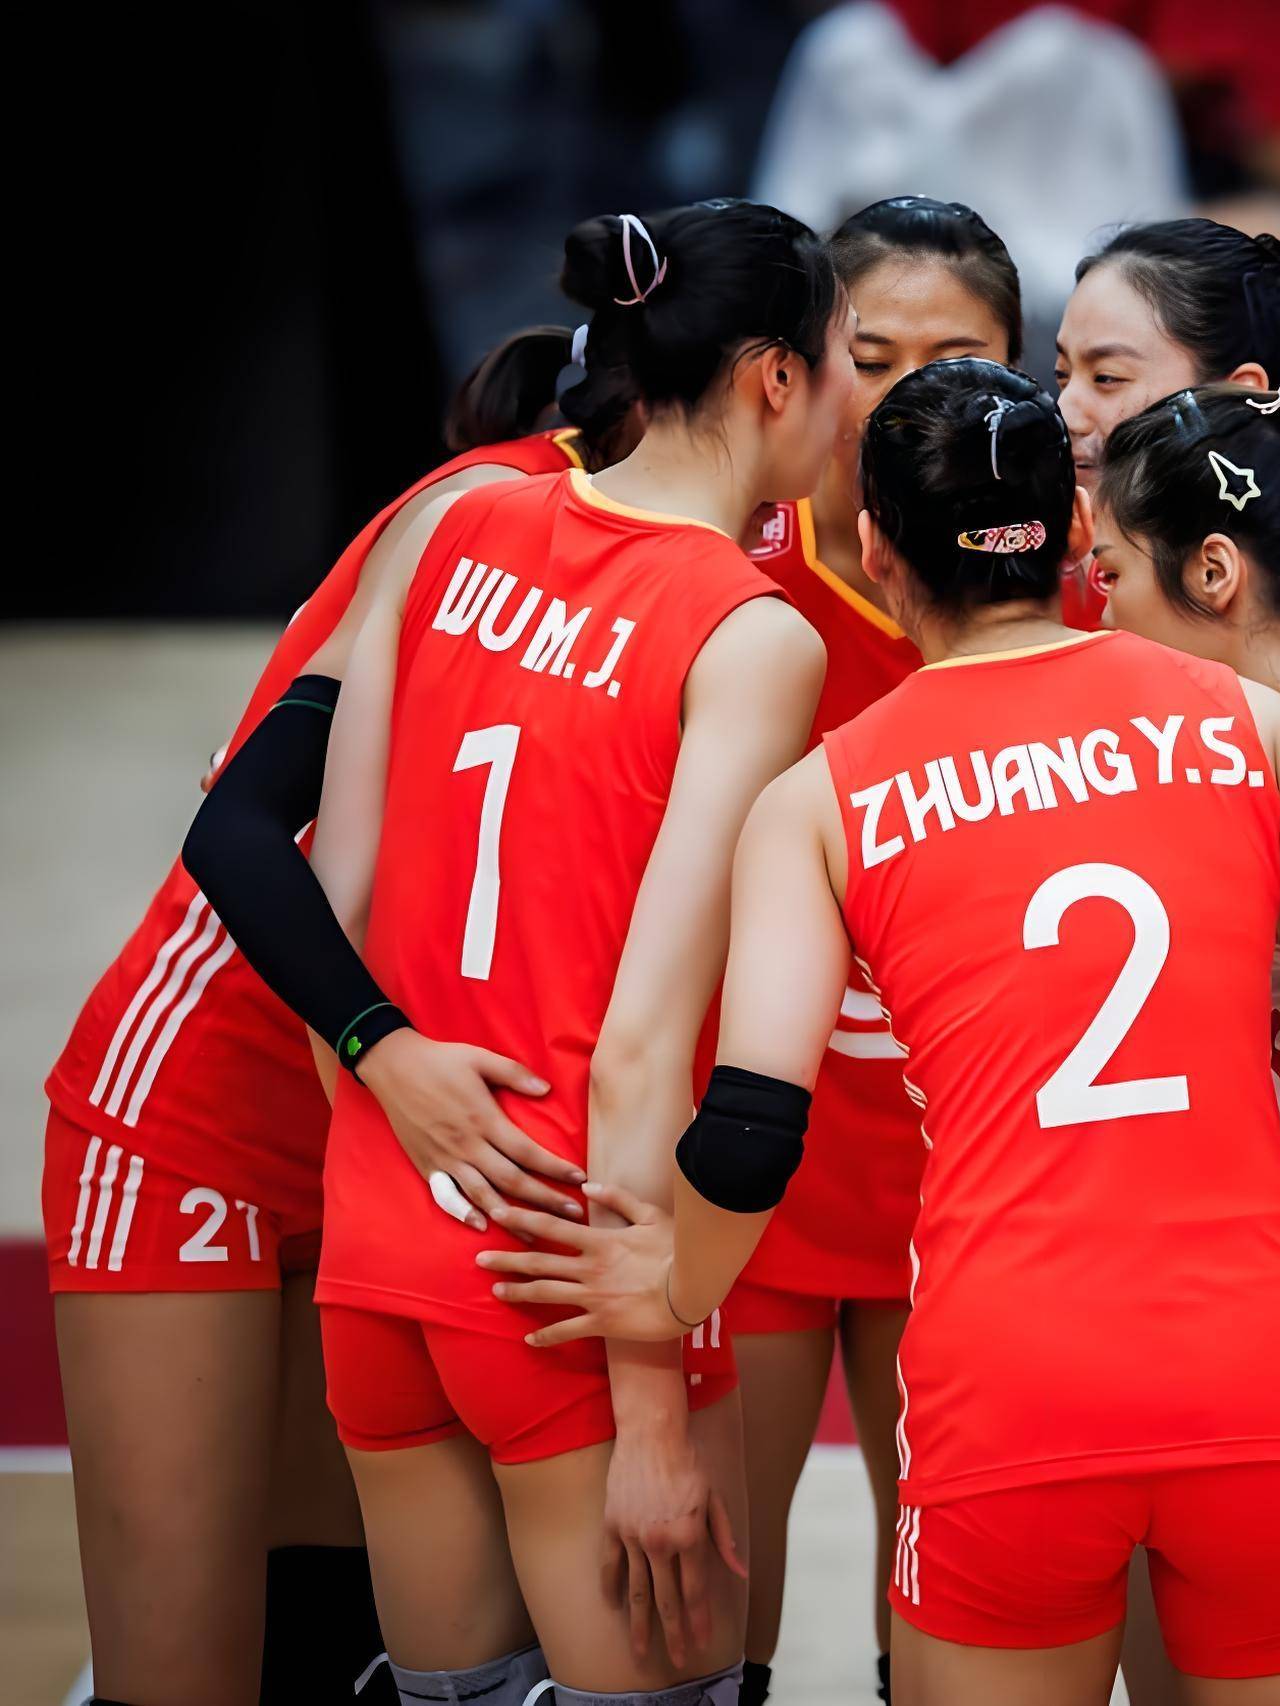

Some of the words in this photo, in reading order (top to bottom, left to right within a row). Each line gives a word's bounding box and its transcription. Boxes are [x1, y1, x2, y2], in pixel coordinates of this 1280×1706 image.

[431, 555, 544, 652] WU
[452, 723, 522, 982] 1
[849, 727, 1139, 870] ZHUANG
[1129, 714, 1265, 788] Y.S.
[1022, 862, 1190, 1128] 2
